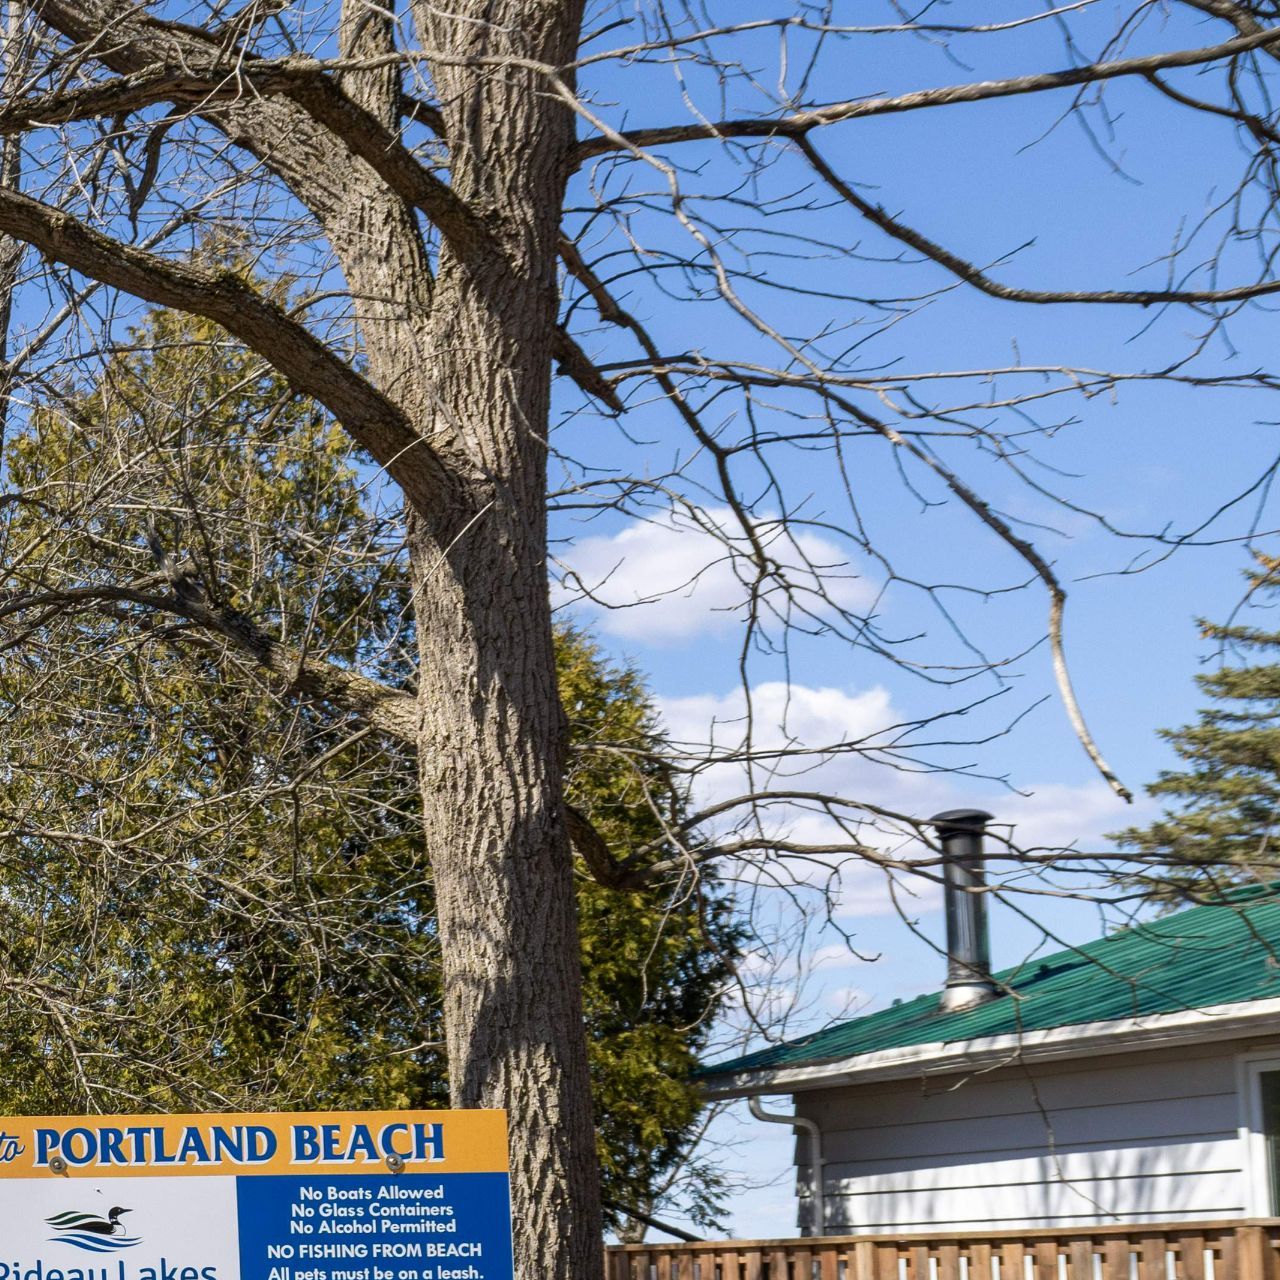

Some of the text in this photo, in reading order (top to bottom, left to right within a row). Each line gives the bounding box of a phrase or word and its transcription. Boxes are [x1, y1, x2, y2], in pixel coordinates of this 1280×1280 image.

[32, 1125, 278, 1167] PORTLAND
[289, 1123, 445, 1164] BEACH
[300, 1185, 443, 1200] No Boats Allowed
[292, 1202, 453, 1217] No Glass Containers
[291, 1219, 456, 1234] No Alcohol Permitted
[268, 1243, 481, 1258] NO FISHING FROM BEACH
